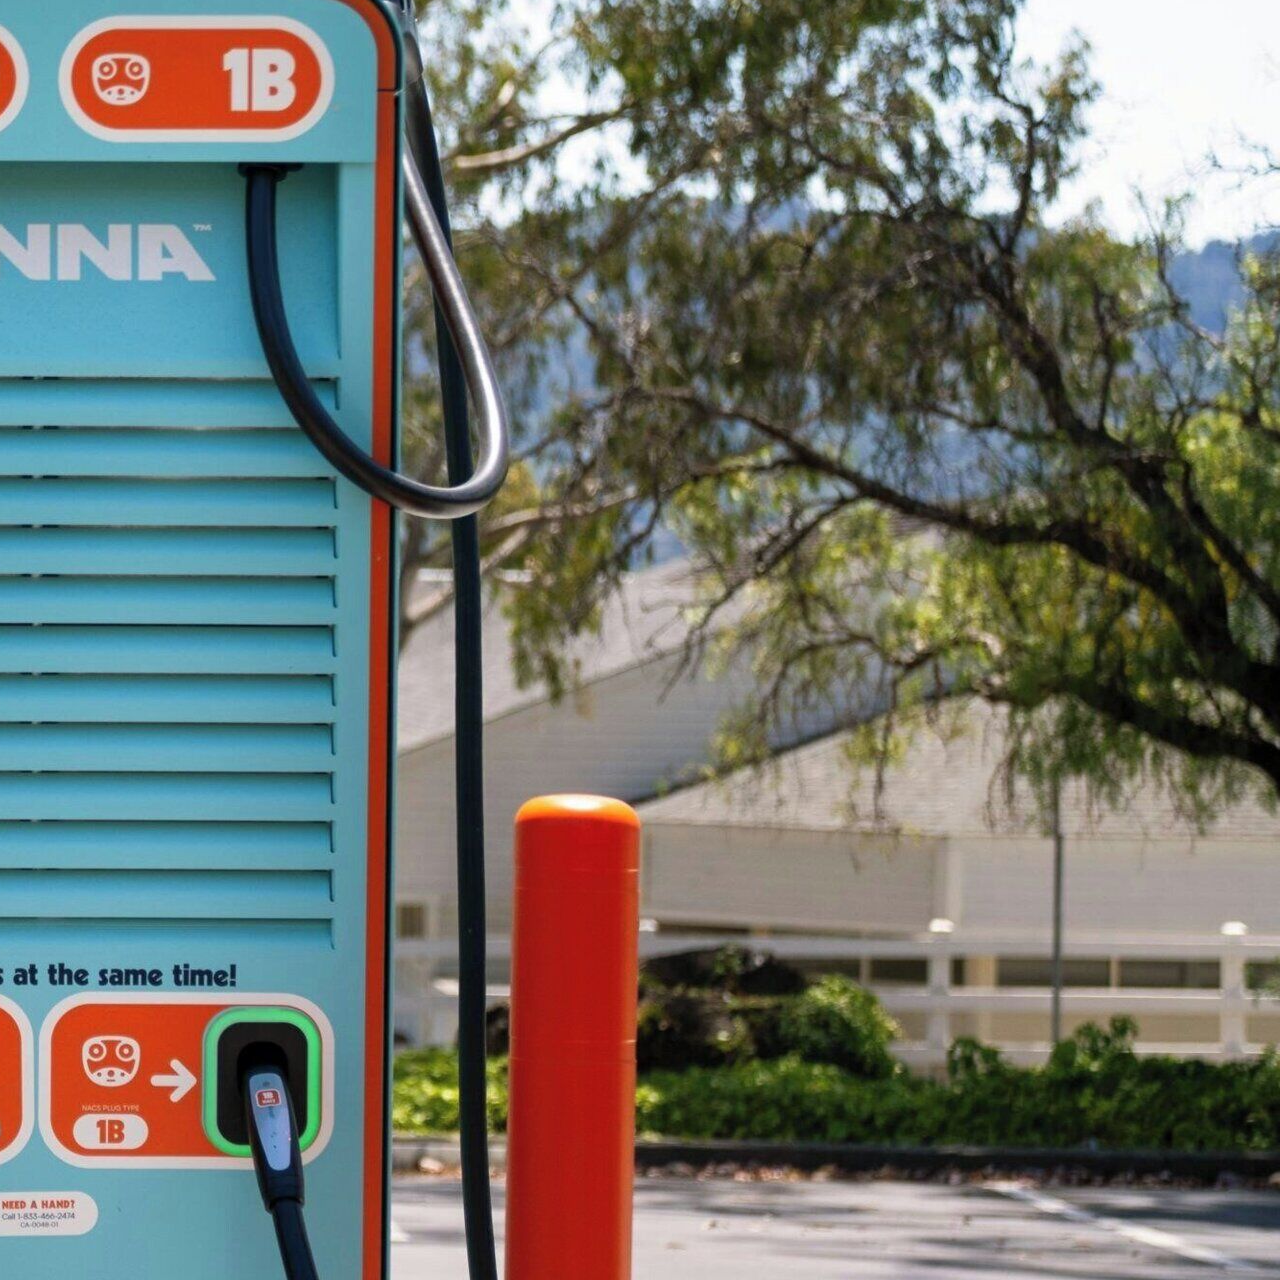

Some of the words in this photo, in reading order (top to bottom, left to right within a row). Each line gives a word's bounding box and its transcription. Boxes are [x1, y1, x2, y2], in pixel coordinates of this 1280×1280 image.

[222, 47, 297, 112] 1B
[13, 964, 38, 986] at
[47, 963, 89, 986] the
[98, 968, 163, 986] same
[172, 963, 237, 987] time!
[96, 1119, 125, 1144] 1B
[2, 1200, 27, 1210] NEED
[30, 1200, 38, 1209] A
[41, 1199, 76, 1209] HAND?
